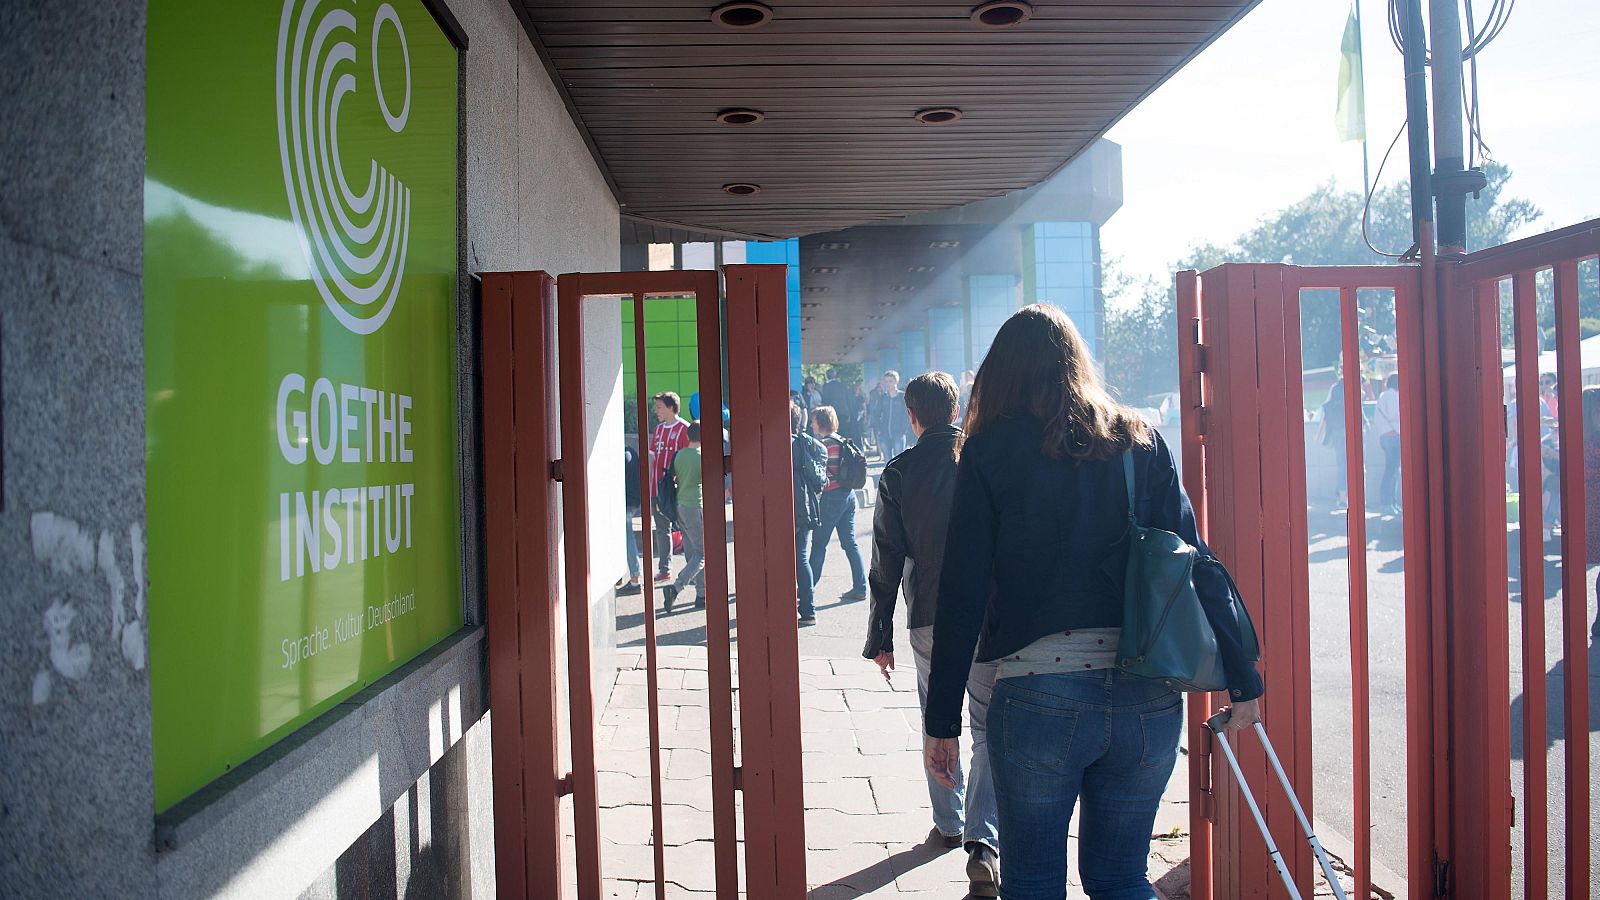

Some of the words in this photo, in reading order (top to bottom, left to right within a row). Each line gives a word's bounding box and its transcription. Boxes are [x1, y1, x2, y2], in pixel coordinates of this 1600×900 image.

[276, 373, 414, 465] GOETHE
[279, 483, 415, 582] INSTITUT
[281, 624, 331, 670] Sprache.
[335, 613, 366, 645] Kultur.
[367, 588, 417, 630] Deutschland.
